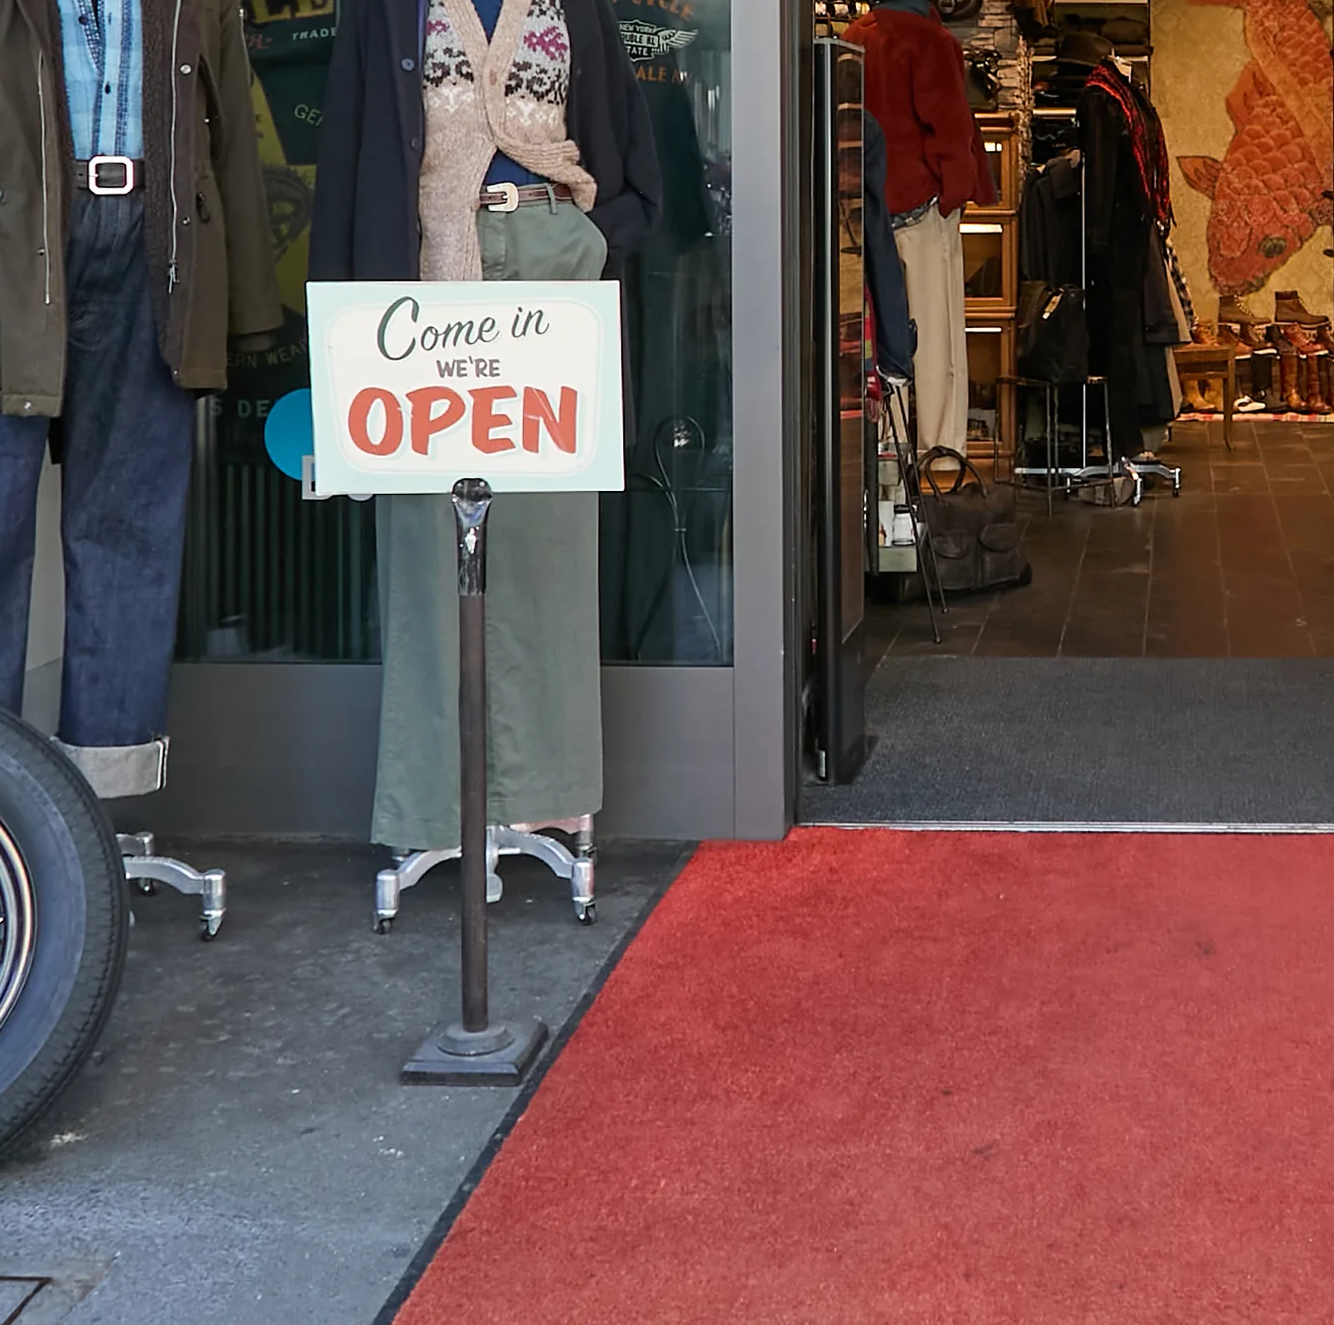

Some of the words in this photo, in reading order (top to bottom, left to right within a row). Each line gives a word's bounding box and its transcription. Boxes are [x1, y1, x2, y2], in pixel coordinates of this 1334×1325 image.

[627, 46, 648, 57] TATE
[377, 296, 501, 361] Come
[511, 306, 550, 339] in
[436, 355, 501, 378] WE'RE
[347, 385, 578, 457] OPEN
